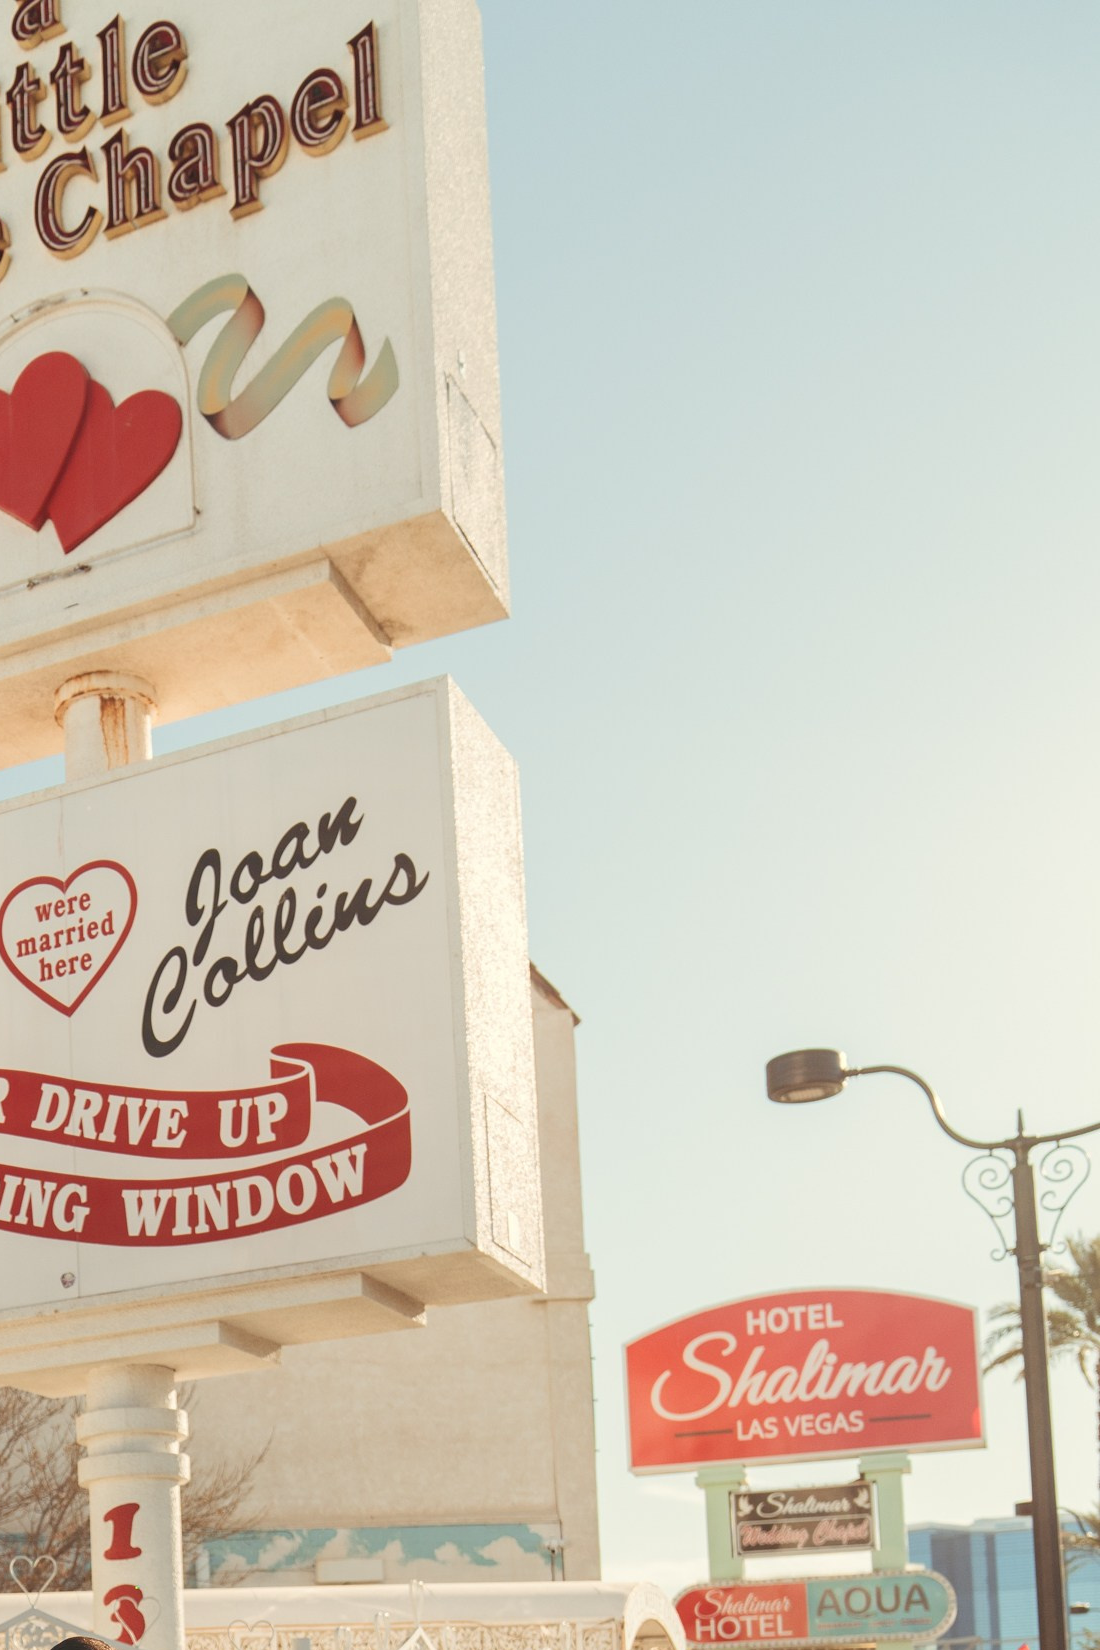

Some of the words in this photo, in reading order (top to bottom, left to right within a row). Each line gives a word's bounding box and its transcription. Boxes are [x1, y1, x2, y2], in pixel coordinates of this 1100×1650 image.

[34, 20, 389, 260] Chapel
[184, 796, 364, 967] Joan
[35, 891, 92, 924] were
[16, 912, 115, 958] married
[38, 950, 93, 983] here
[140, 852, 430, 1058] Collins
[31, 1083, 190, 1149] DRIVE
[217, 1091, 289, 1145] UP
[121, 1144, 369, 1239] WINDOW
[746, 1302, 843, 1336] HOTEL
[651, 1331, 952, 1421] Shalimar
[736, 1416, 779, 1441] LAS
[784, 1410, 865, 1437] VEGAS
[756, 1492, 850, 1518] Shalimar
[740, 1524, 809, 1549] Wedding
[812, 1518, 869, 1546] Chapel
[694, 1589, 791, 1619] Shalimar
[816, 1583, 930, 1618] AQUA
[695, 1614, 793, 1640] HOTEL
